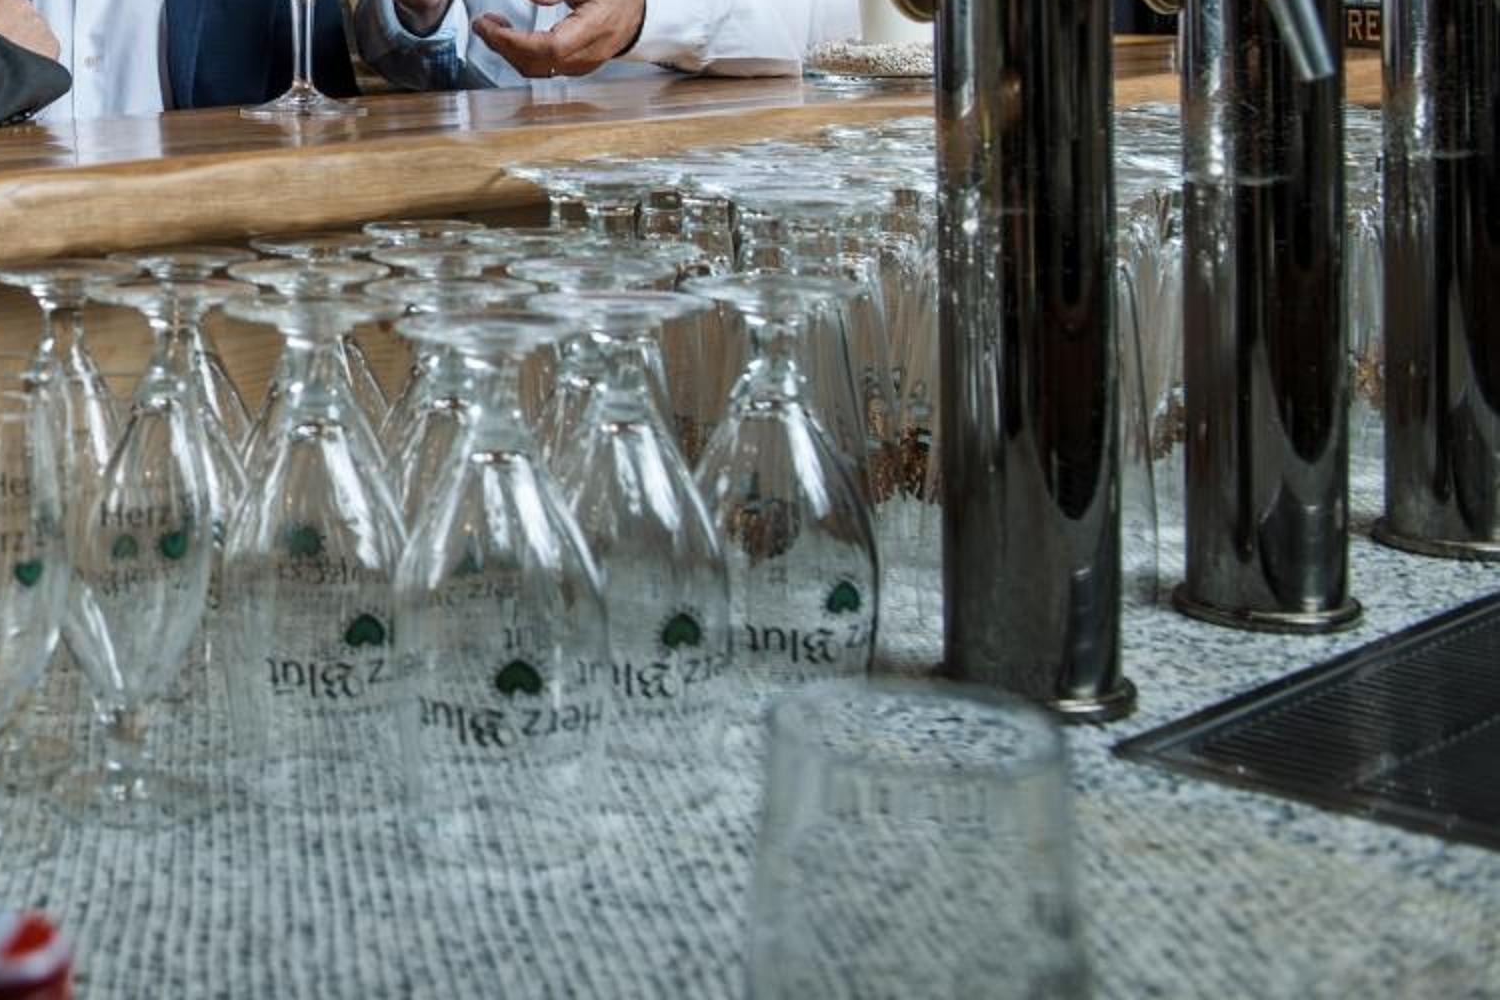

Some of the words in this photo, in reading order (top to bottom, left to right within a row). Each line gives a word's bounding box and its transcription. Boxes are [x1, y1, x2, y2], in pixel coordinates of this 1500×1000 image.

[1347, 8, 1380, 41] RE
[744, 623, 835, 664] Blut
[419, 697, 514, 749] Blut
[519, 703, 603, 739] Herz
